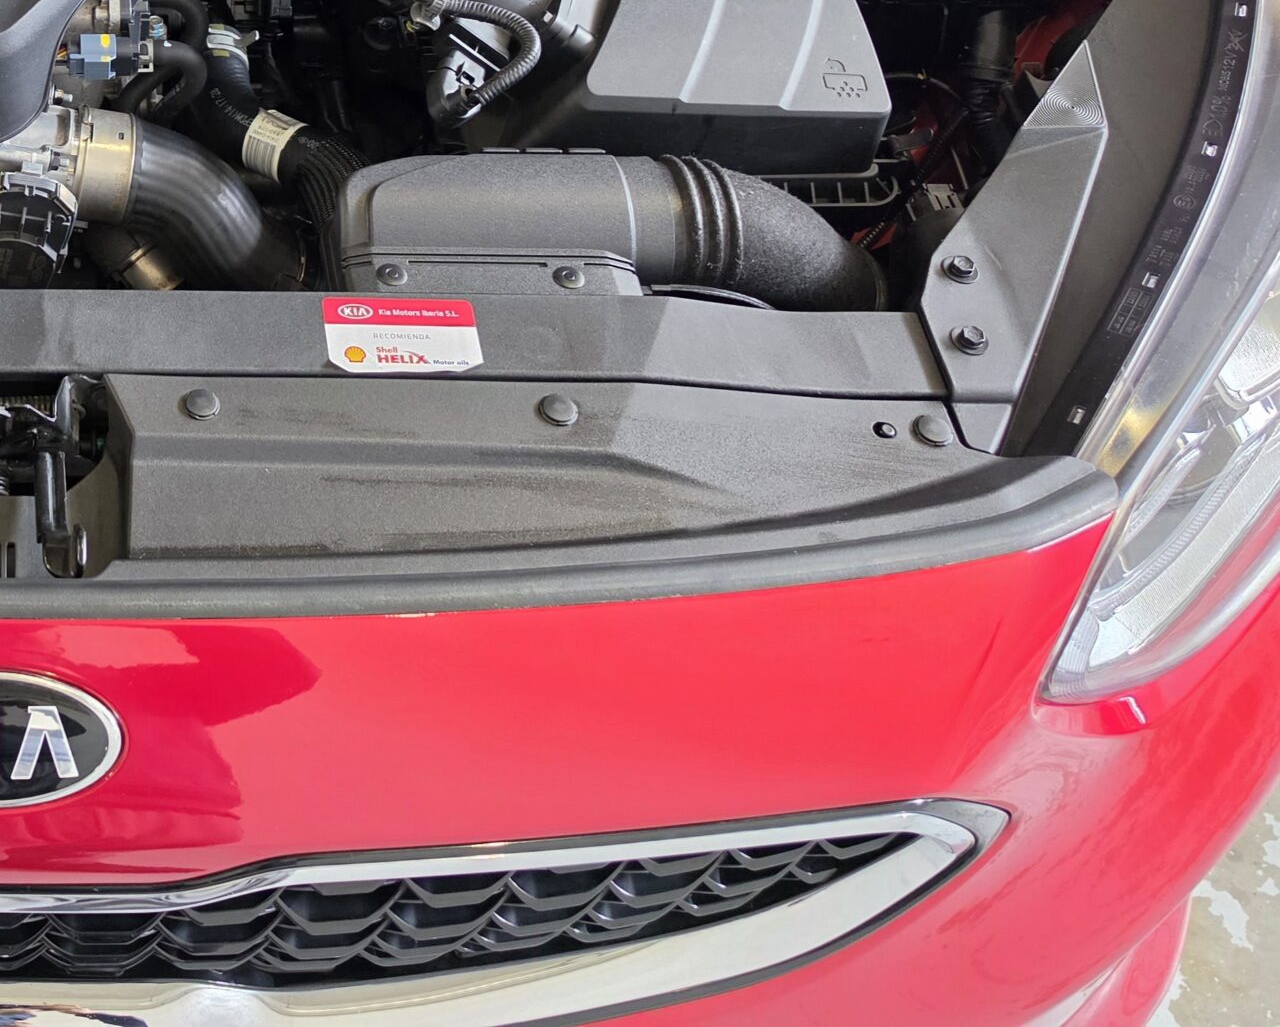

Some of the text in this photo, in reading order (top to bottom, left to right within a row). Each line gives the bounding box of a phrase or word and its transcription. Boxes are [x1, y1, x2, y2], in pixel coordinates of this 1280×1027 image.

[343, 306, 368, 317] KIA
[378, 308, 391, 316] Kia
[422, 309, 444, 317] Iberia
[373, 332, 431, 340] RECOMIENDA
[376, 346, 398, 354] Shell
[376, 352, 431, 365] HELIX
